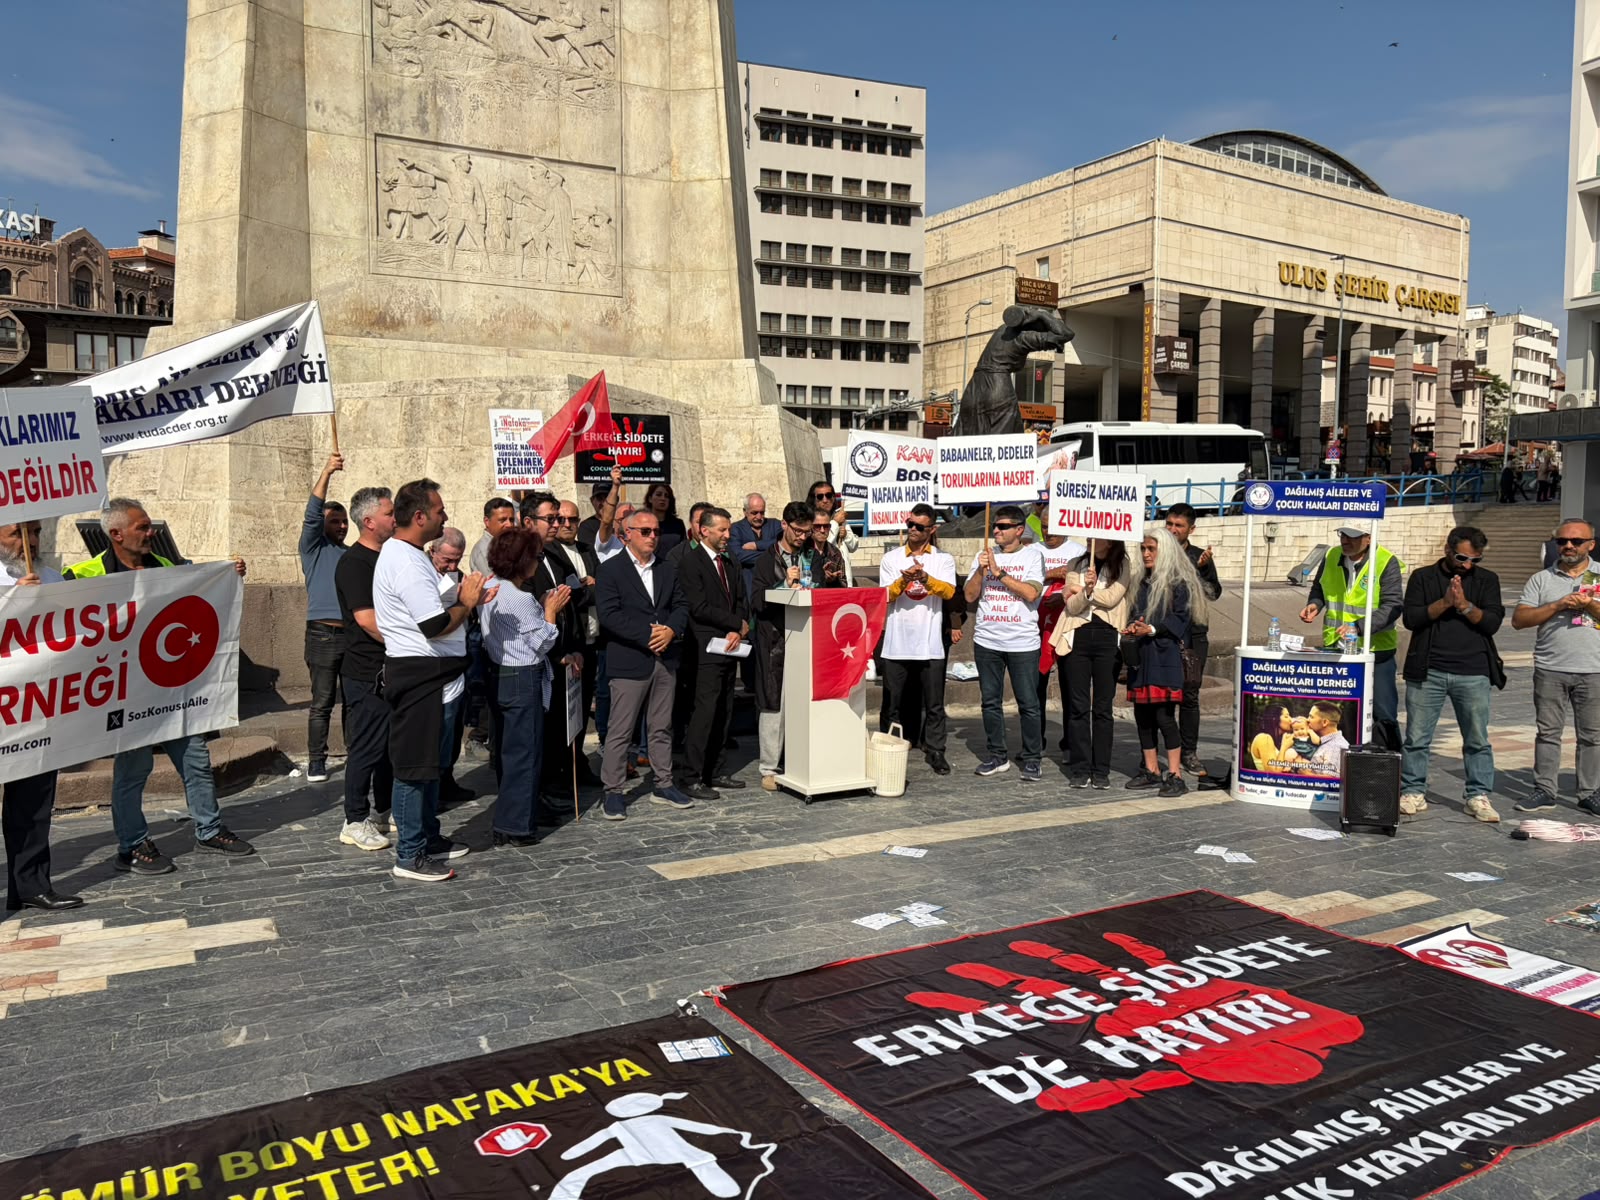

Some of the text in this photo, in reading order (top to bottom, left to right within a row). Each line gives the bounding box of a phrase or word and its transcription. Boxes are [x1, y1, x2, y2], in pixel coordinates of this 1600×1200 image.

[1278, 261, 1461, 316] ULUS ŞEHİR ÇARŞISI
[211, 353, 328, 403] DERNEĞİ
[101, 414, 228, 444] www.tudacder.org.tr
[624, 432, 665, 444] ŞİDDETE
[494, 442, 518, 451] SÜRESİZ
[608, 446, 642, 456] HAYIR!
[896, 444, 934, 465] KAN
[940, 445, 1034, 463] BABAANELER, DEDELER
[497, 457, 543, 467] EVLENMEK
[497, 466, 544, 475] APTALLIKTIR
[0, 453, 97, 506] DEĞİLDİR
[498, 475, 545, 485] KÖLELİĞE SON
[941, 470, 1035, 488] TORUNLARINA HASRET
[872, 482, 929, 504] NAFAKA HAPSİ
[1056, 479, 1137, 502] SÜRESİZ NAFAKA
[1285, 486, 1324, 499] DAĞILMIŞ
[1326, 486, 1359, 498] AİLELER
[1361, 489, 1372, 498] VE
[1275, 500, 1380, 512] ÇOCUK HAKLARI DERNEĞİ
[871, 509, 899, 525] İNSANLIK
[1058, 506, 1133, 532] ZULÜMDÜR
[991, 605, 1009, 613] AİLE
[0, 601, 136, 658] NUSU
[1252, 662, 1348, 676] DAĞILMIŞ AİLELER VE
[0, 650, 128, 726] RNEĞİ
[1244, 674, 1356, 689] ÇOCUK HAKLARI DERNEĞİ
[128, 696, 209, 722] SozKonusuAile
[852, 935, 1332, 1067] ERKEĞE ŞİDDETE
[968, 993, 1311, 1105] DE HAYIR!
[218, 1122, 371, 1183] BOYU
[381, 1058, 651, 1140] NAFAKA'YA
[1165, 1043, 1567, 1199] DAĞILMIŞ AİLELER VE
[1337, 1105, 1528, 1187] HAKLARI
[1504, 1063, 1600, 1115] DERN
